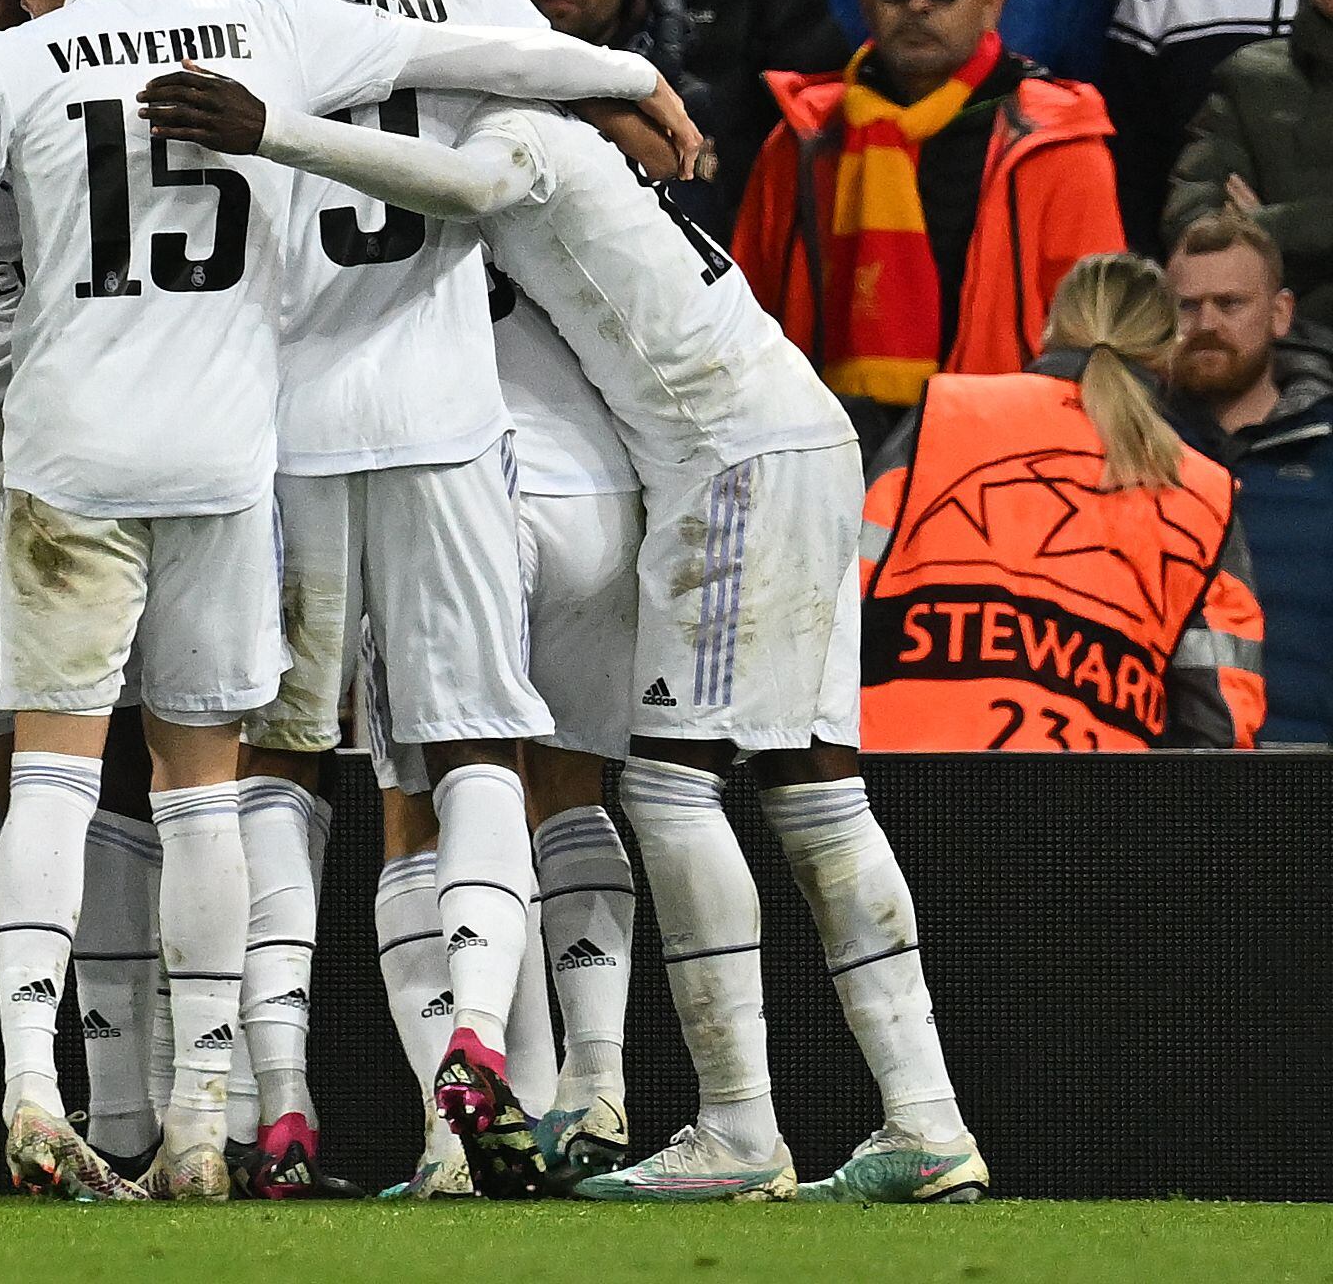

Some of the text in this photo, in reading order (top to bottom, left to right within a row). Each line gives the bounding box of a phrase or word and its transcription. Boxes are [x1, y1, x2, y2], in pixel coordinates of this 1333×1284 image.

[47, 23, 252, 74] VALVERDE
[66, 99, 251, 298] 15
[642, 695, 677, 707] adidas
[556, 955, 617, 973] adidas
